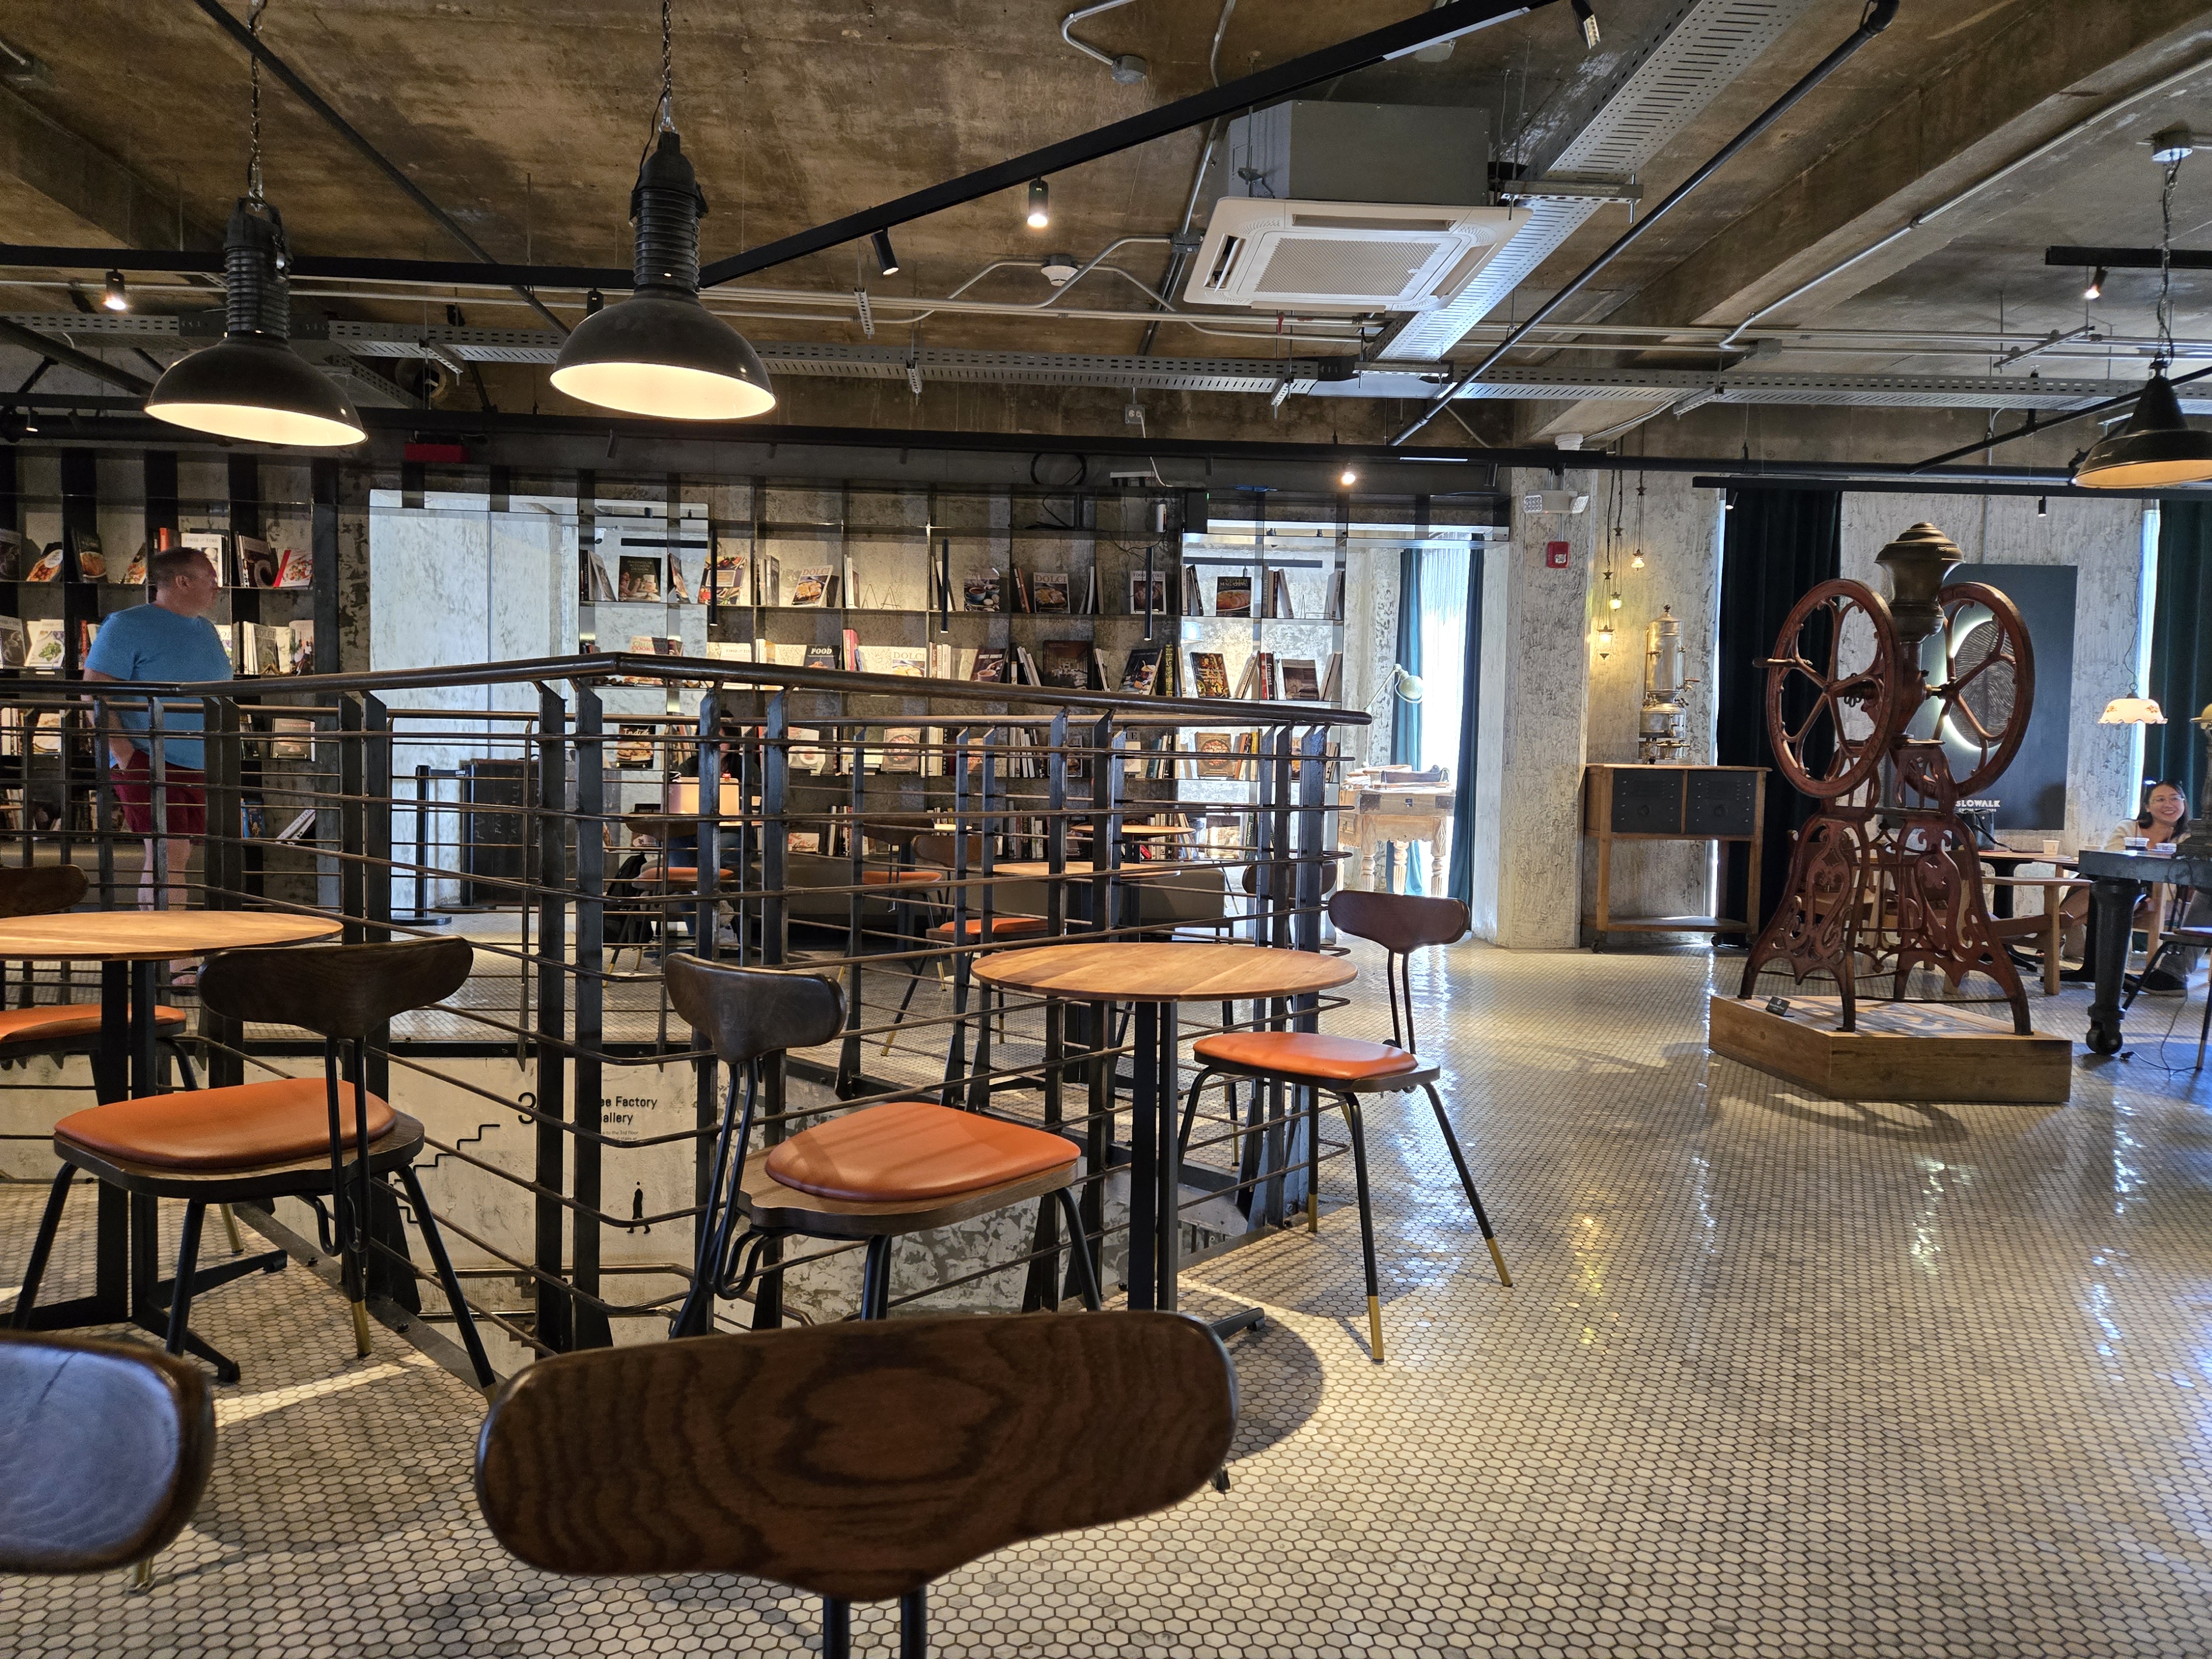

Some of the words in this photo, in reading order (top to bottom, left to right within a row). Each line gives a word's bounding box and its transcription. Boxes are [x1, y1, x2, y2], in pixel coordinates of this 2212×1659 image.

[802, 567, 831, 576] DOLCI
[254, 628, 275, 639] DOLCI
[893, 651, 926, 660] DOLCI
[518, 1092, 537, 1124] 3
[615, 1095, 658, 1110] Factory
[601, 1112, 634, 1125] allery
